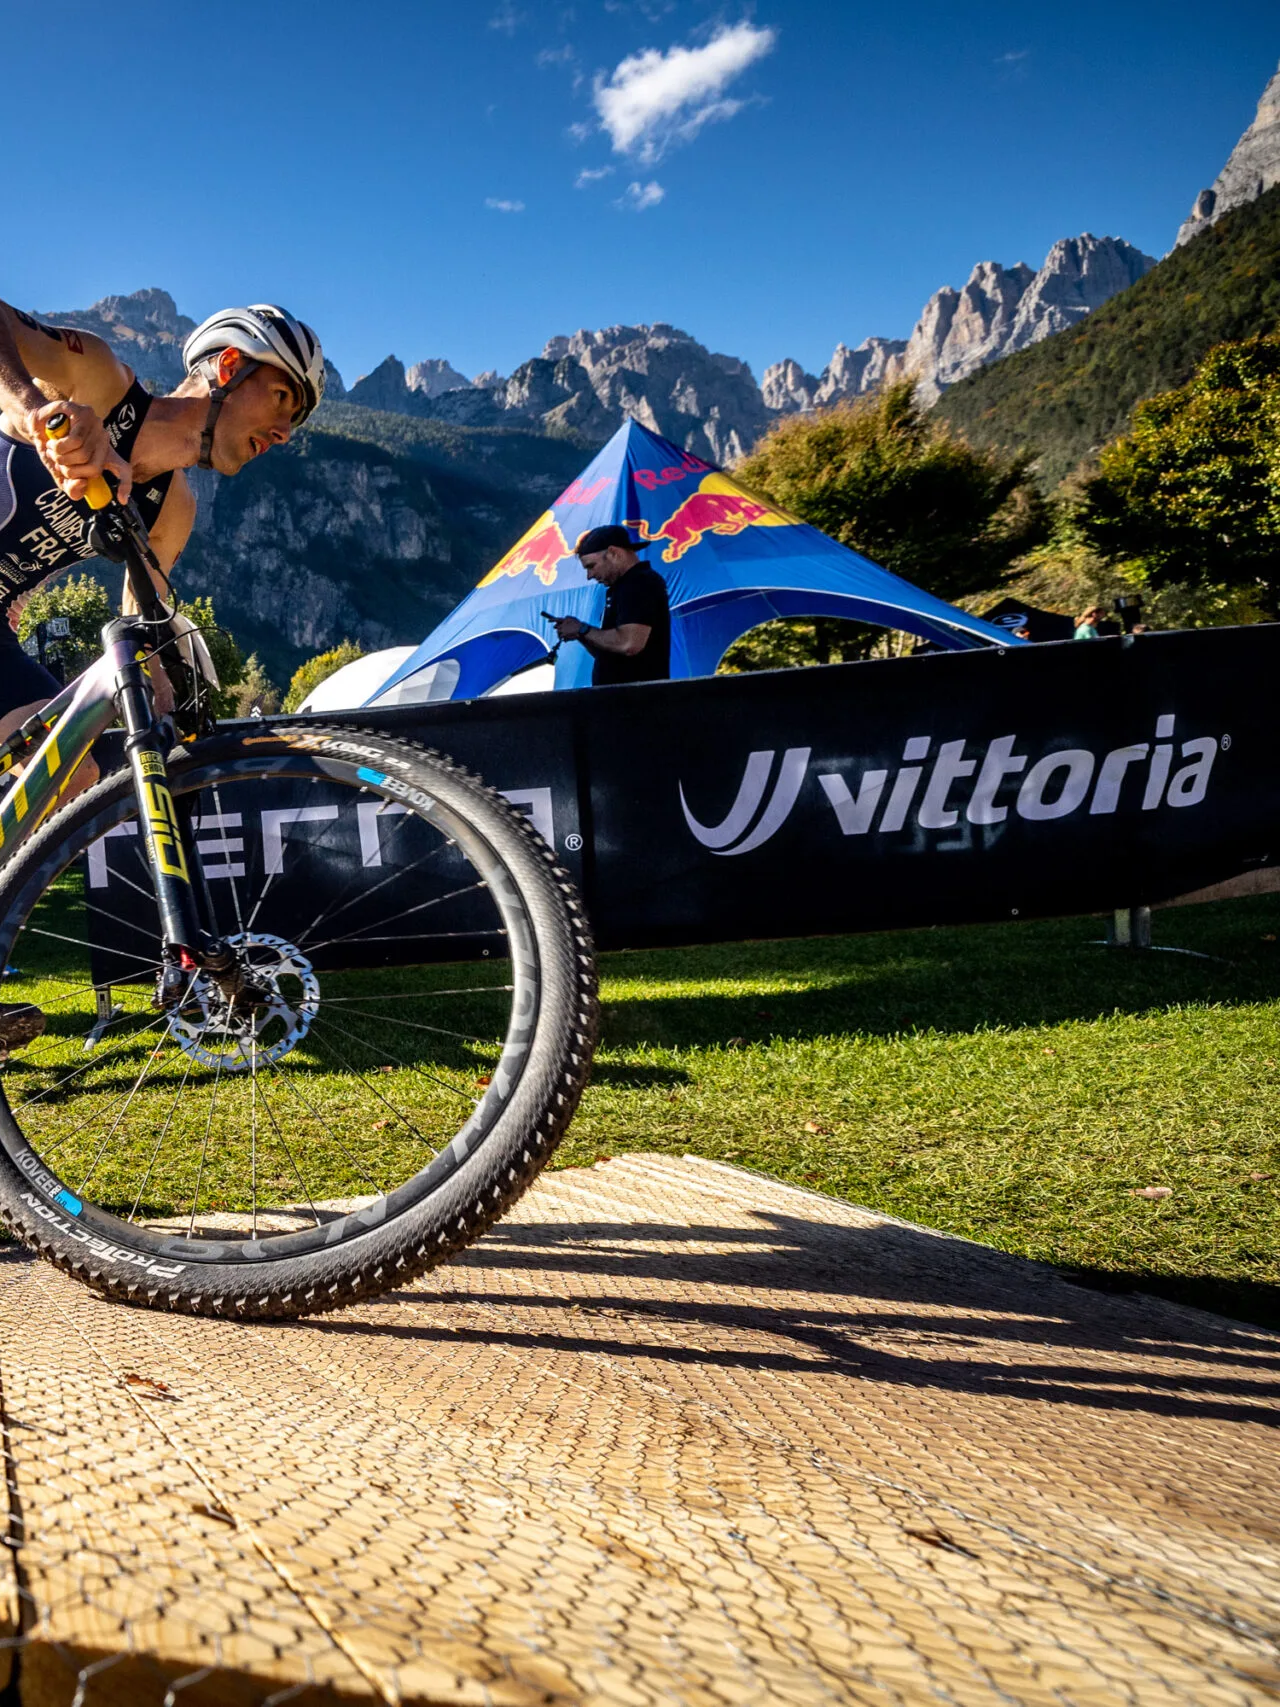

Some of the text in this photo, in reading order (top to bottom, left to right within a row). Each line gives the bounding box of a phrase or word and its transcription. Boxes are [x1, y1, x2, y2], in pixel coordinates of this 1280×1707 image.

[632, 452, 710, 491] Red
[20, 526, 68, 566] FRA
[818, 713, 1219, 836] vittoria
[15, 1147, 58, 1193] KOVEE
[20, 1192, 186, 1279] PROTECTION
